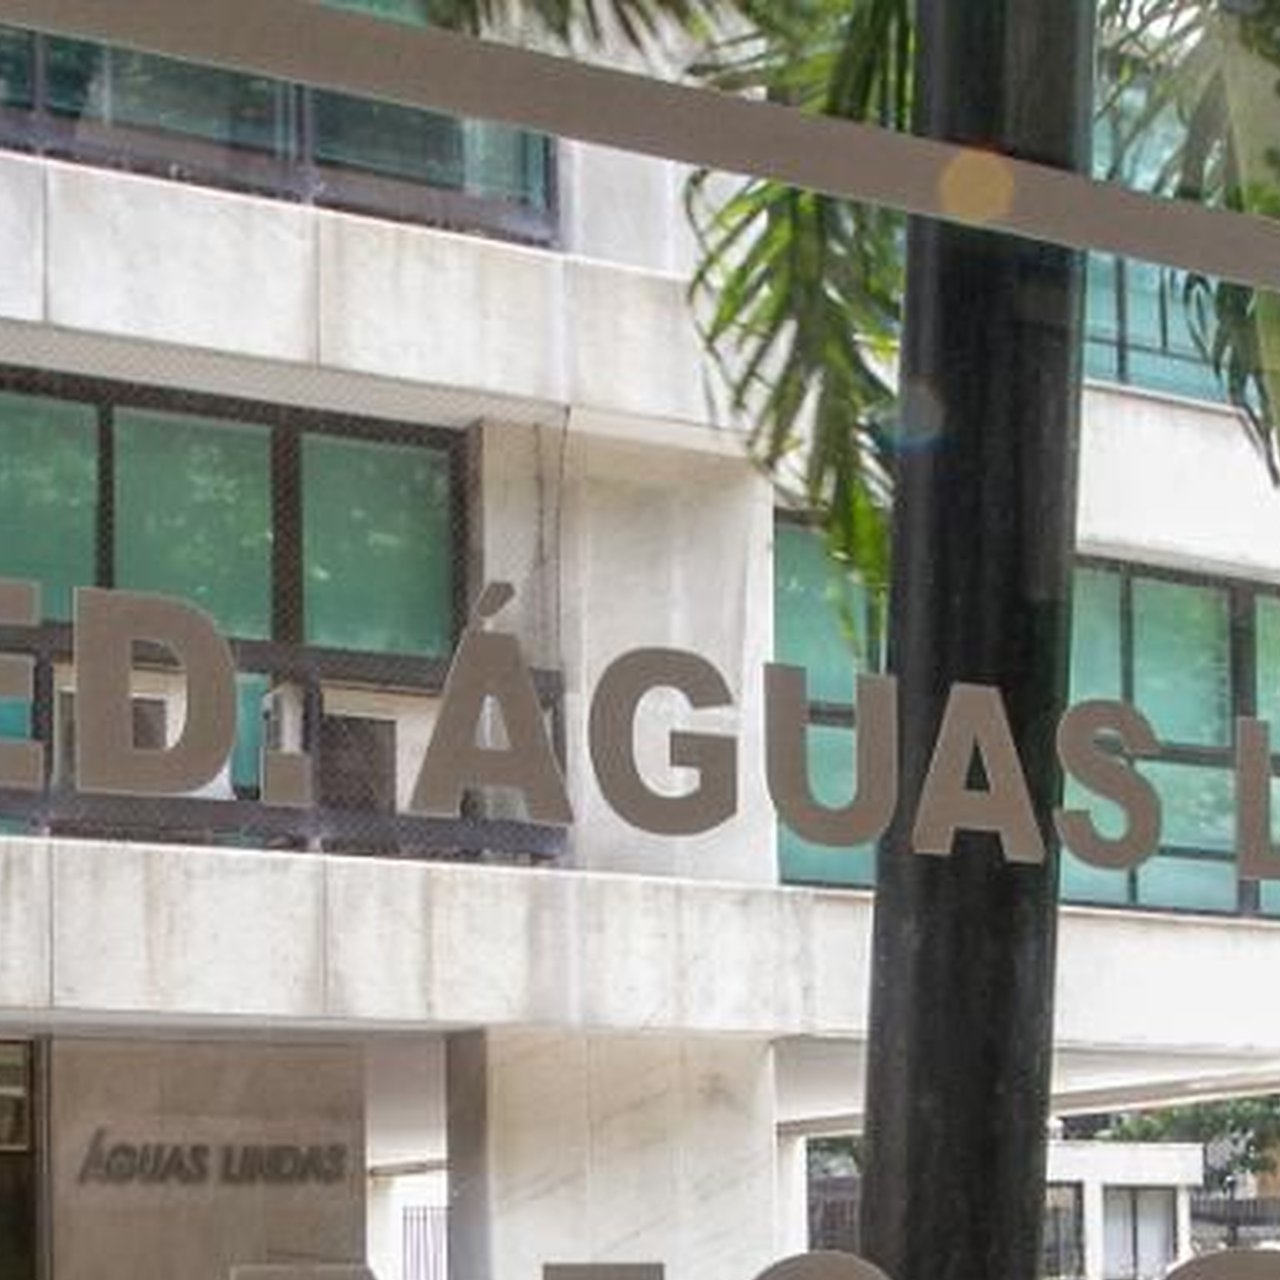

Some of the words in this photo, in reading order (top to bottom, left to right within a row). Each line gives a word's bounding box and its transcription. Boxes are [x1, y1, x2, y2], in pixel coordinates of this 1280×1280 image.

[406, 580, 1163, 872] ÁGUAS
[78, 1127, 210, 1186] ÁGUAS
[223, 1144, 349, 1184] LINDAS
